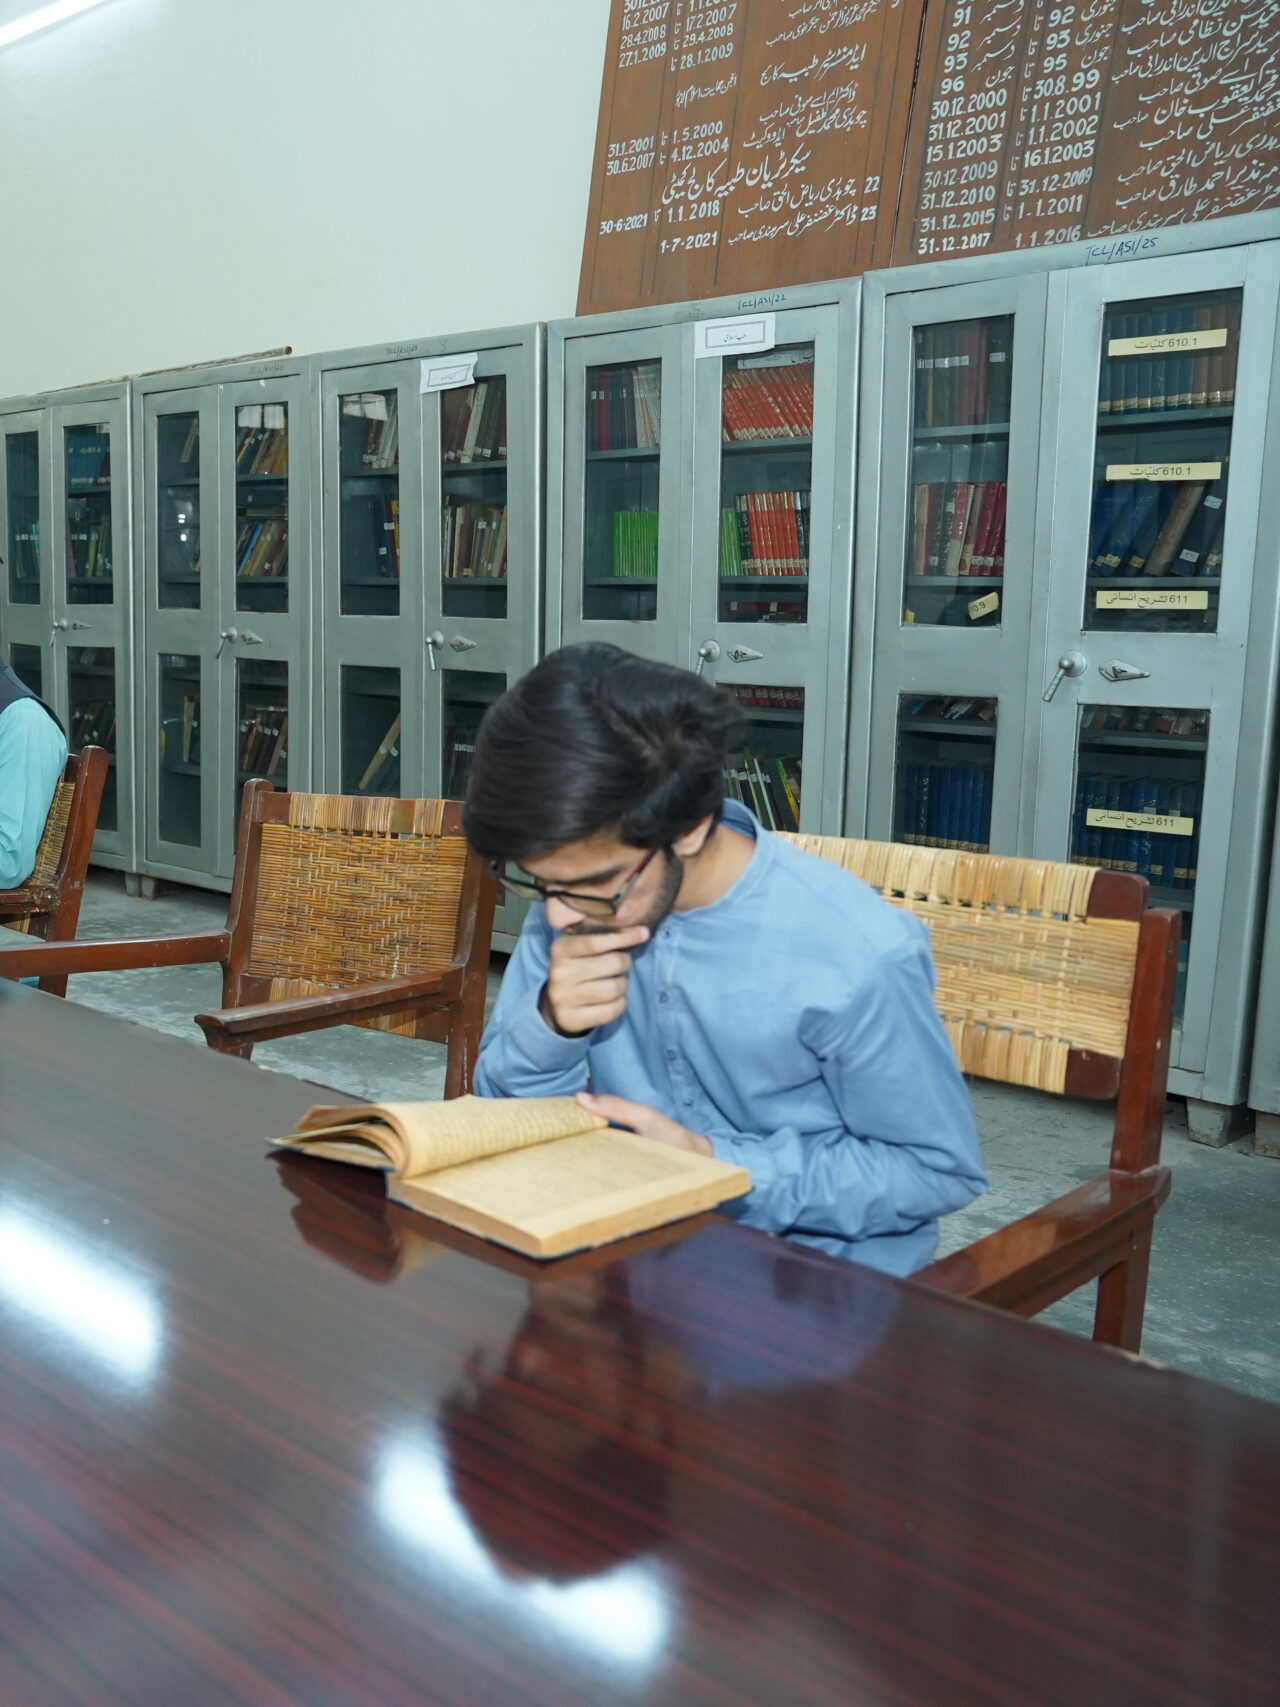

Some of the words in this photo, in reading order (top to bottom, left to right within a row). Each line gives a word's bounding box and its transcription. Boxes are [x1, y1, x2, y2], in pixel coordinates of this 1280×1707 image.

[952, 5, 972, 27] 91
[1048, 5, 1075, 27] 92
[947, 30, 972, 52] 92
[1046, 28, 1071, 51] 93
[944, 52, 968, 73] 93
[1043, 53, 1067, 73] 95
[941, 75, 965, 95] 96
[864, 176, 880, 194] 22
[860, 205, 878, 222] 23
[1169, 594, 1188, 603] 611
[1155, 817, 1174, 827] 611
